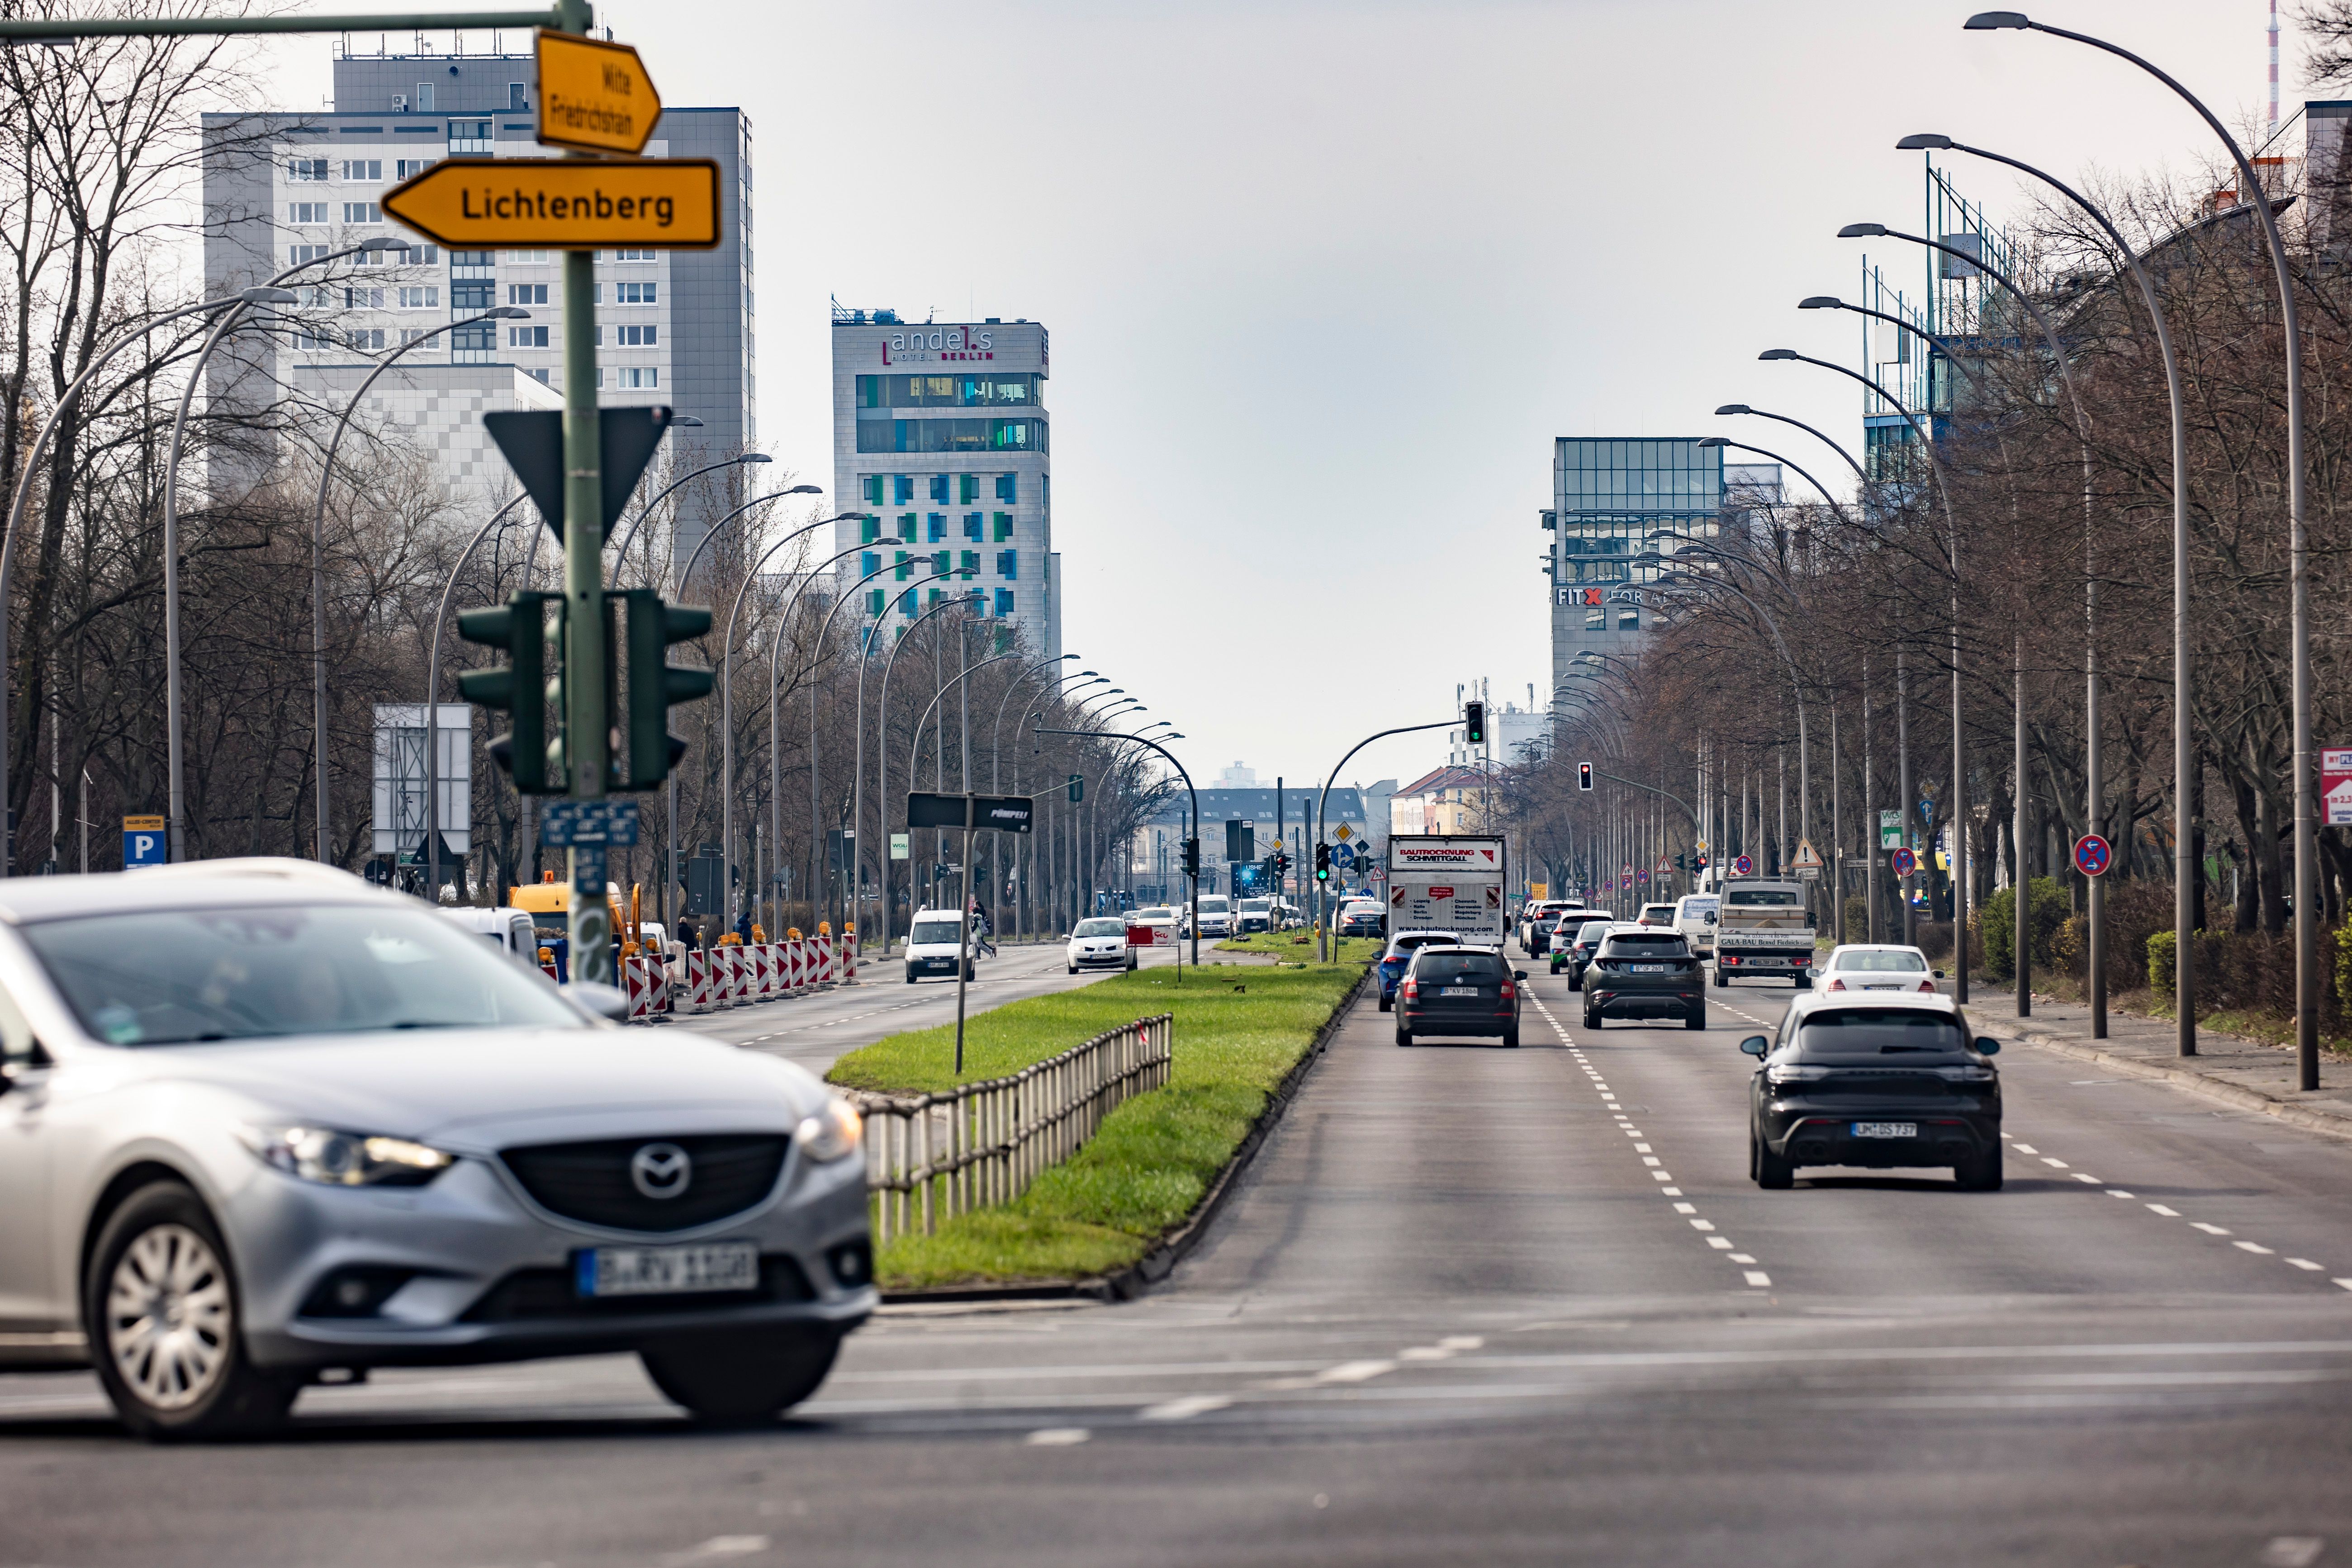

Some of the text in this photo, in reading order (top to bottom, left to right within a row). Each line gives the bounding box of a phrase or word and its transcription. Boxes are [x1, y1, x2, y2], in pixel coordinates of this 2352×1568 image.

[602, 63, 631, 96] Mitte
[550, 94, 631, 135] Friedrichshain
[462, 188, 673, 227] Lichtenberg
[1558, 588, 1603, 605] FITX
[1610, 591, 1642, 603] FOR
[136, 836, 154, 859] P
